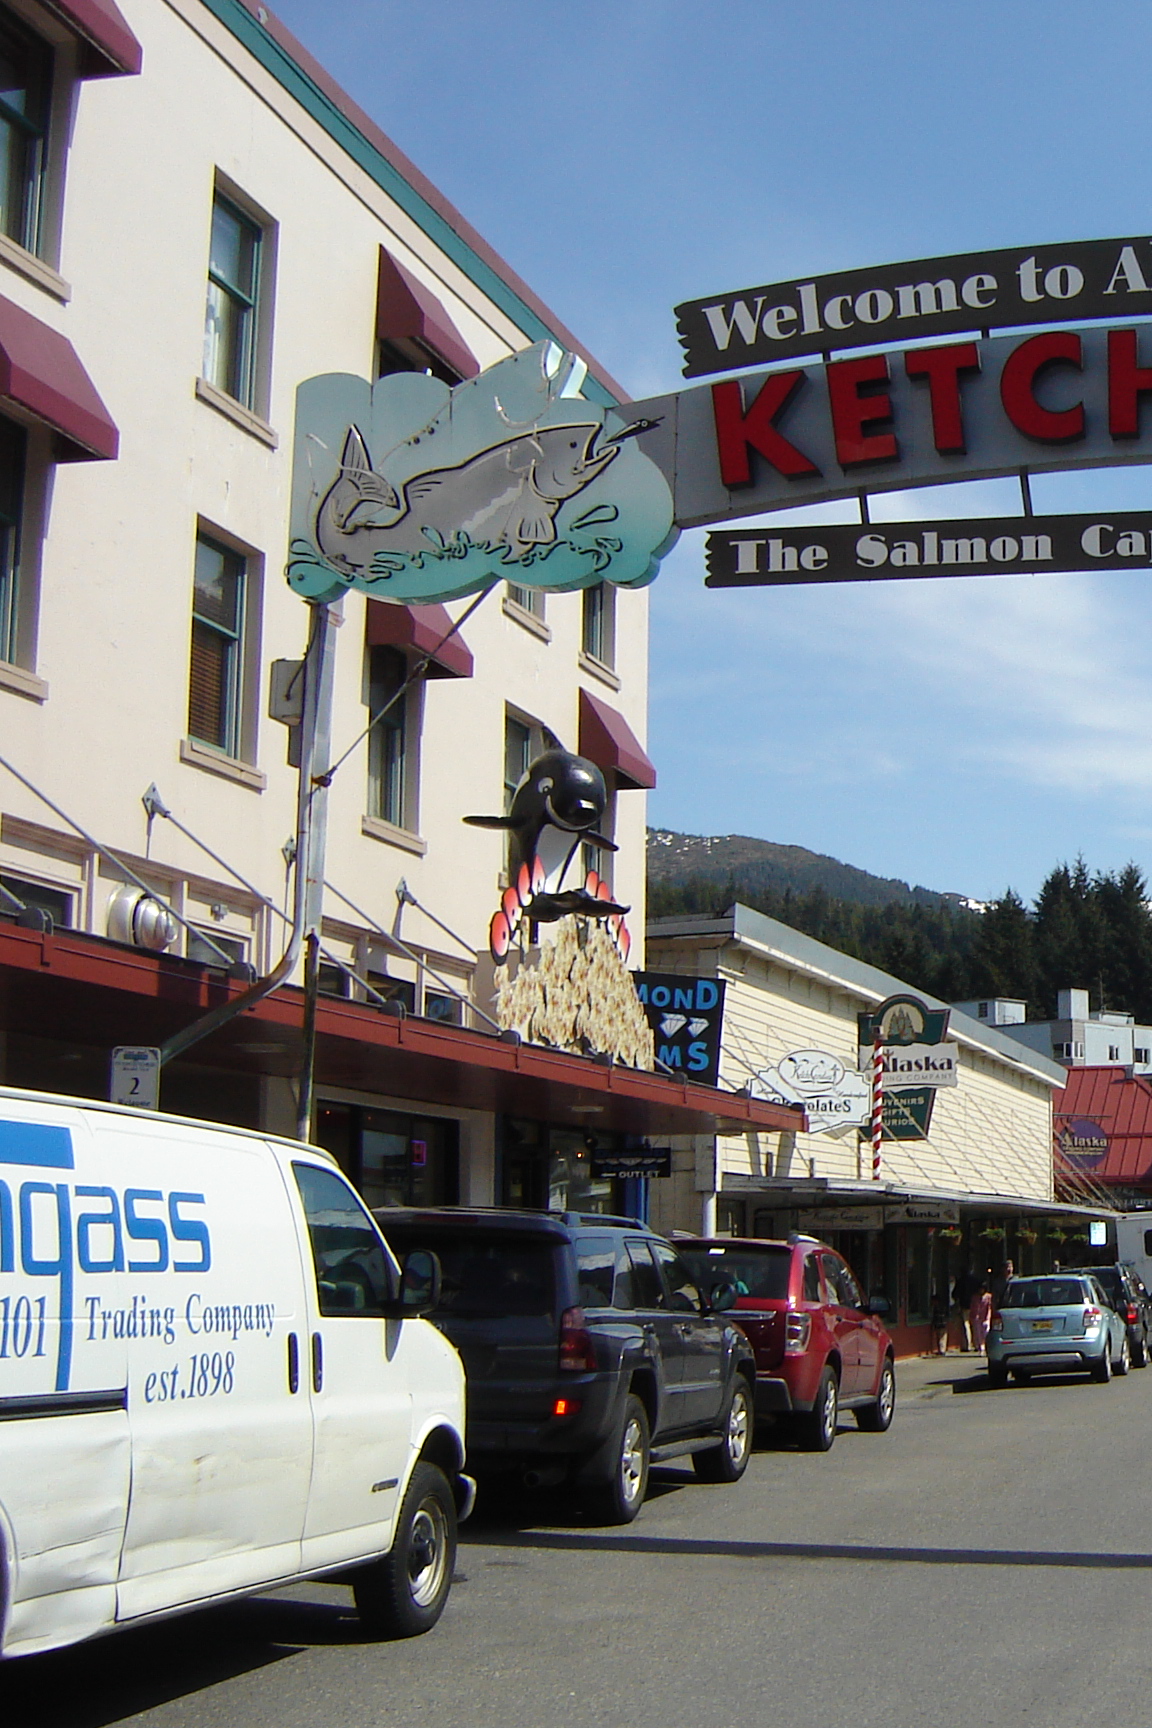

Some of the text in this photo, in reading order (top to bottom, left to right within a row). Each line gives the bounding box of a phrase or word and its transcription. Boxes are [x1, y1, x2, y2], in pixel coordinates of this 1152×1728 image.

[701, 272, 998, 352] Welcome
[1016, 256, 1085, 303] to
[729, 538, 829, 574] The
[856, 531, 1054, 568] Salmon
[129, 1077, 140, 1095] 2
[618, 1170, 660, 1178] OUTLET
[85, 1295, 175, 1344] Trading
[185, 1294, 275, 1341] Company
